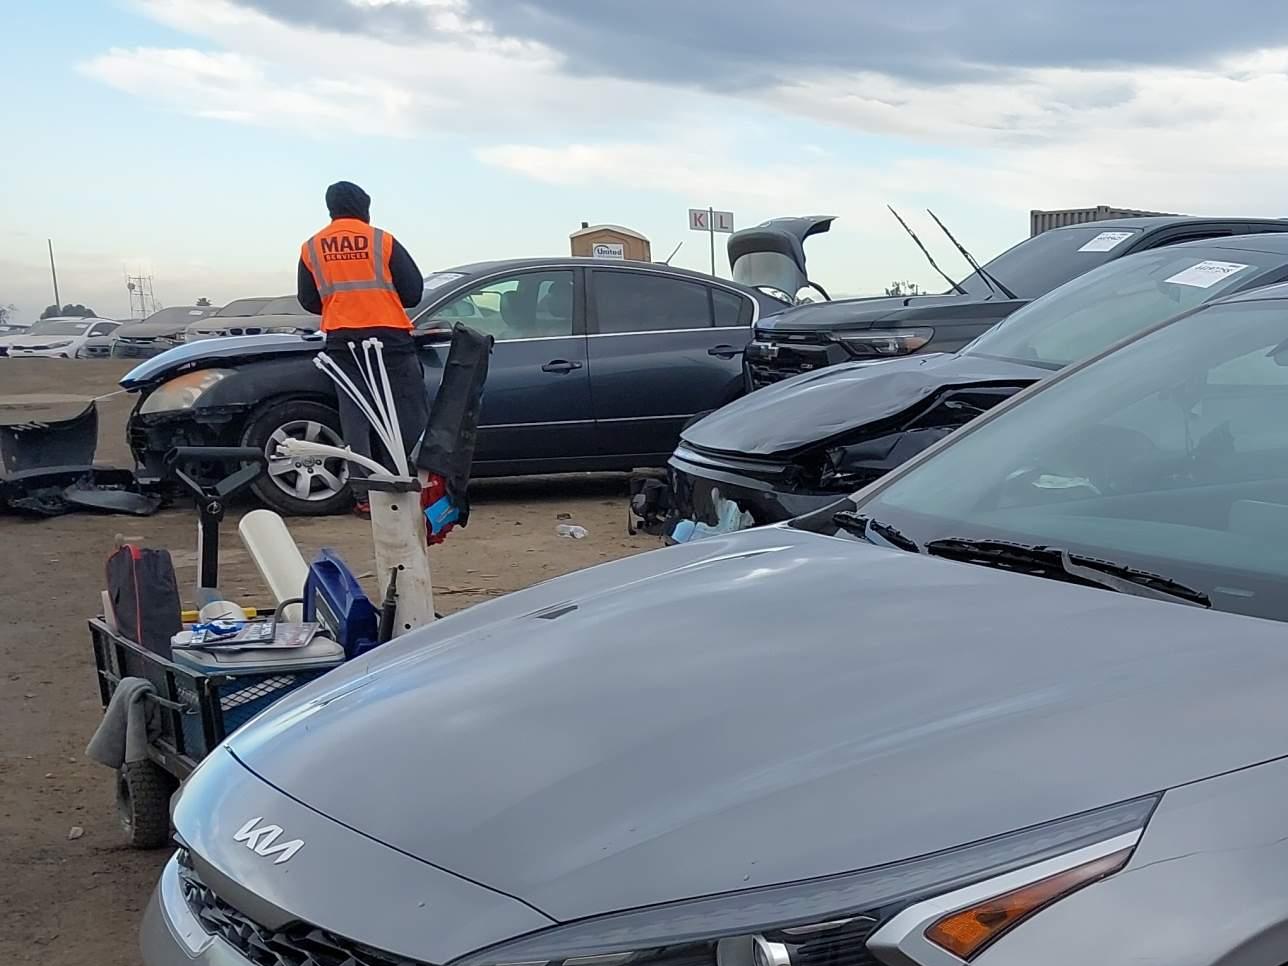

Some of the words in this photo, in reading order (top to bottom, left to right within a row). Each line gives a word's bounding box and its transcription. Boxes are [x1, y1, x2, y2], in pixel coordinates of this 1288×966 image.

[693, 212, 705, 228] K
[719, 214, 729, 230] L
[320, 235, 369, 253] MAD
[325, 252, 368, 261] SERVICES
